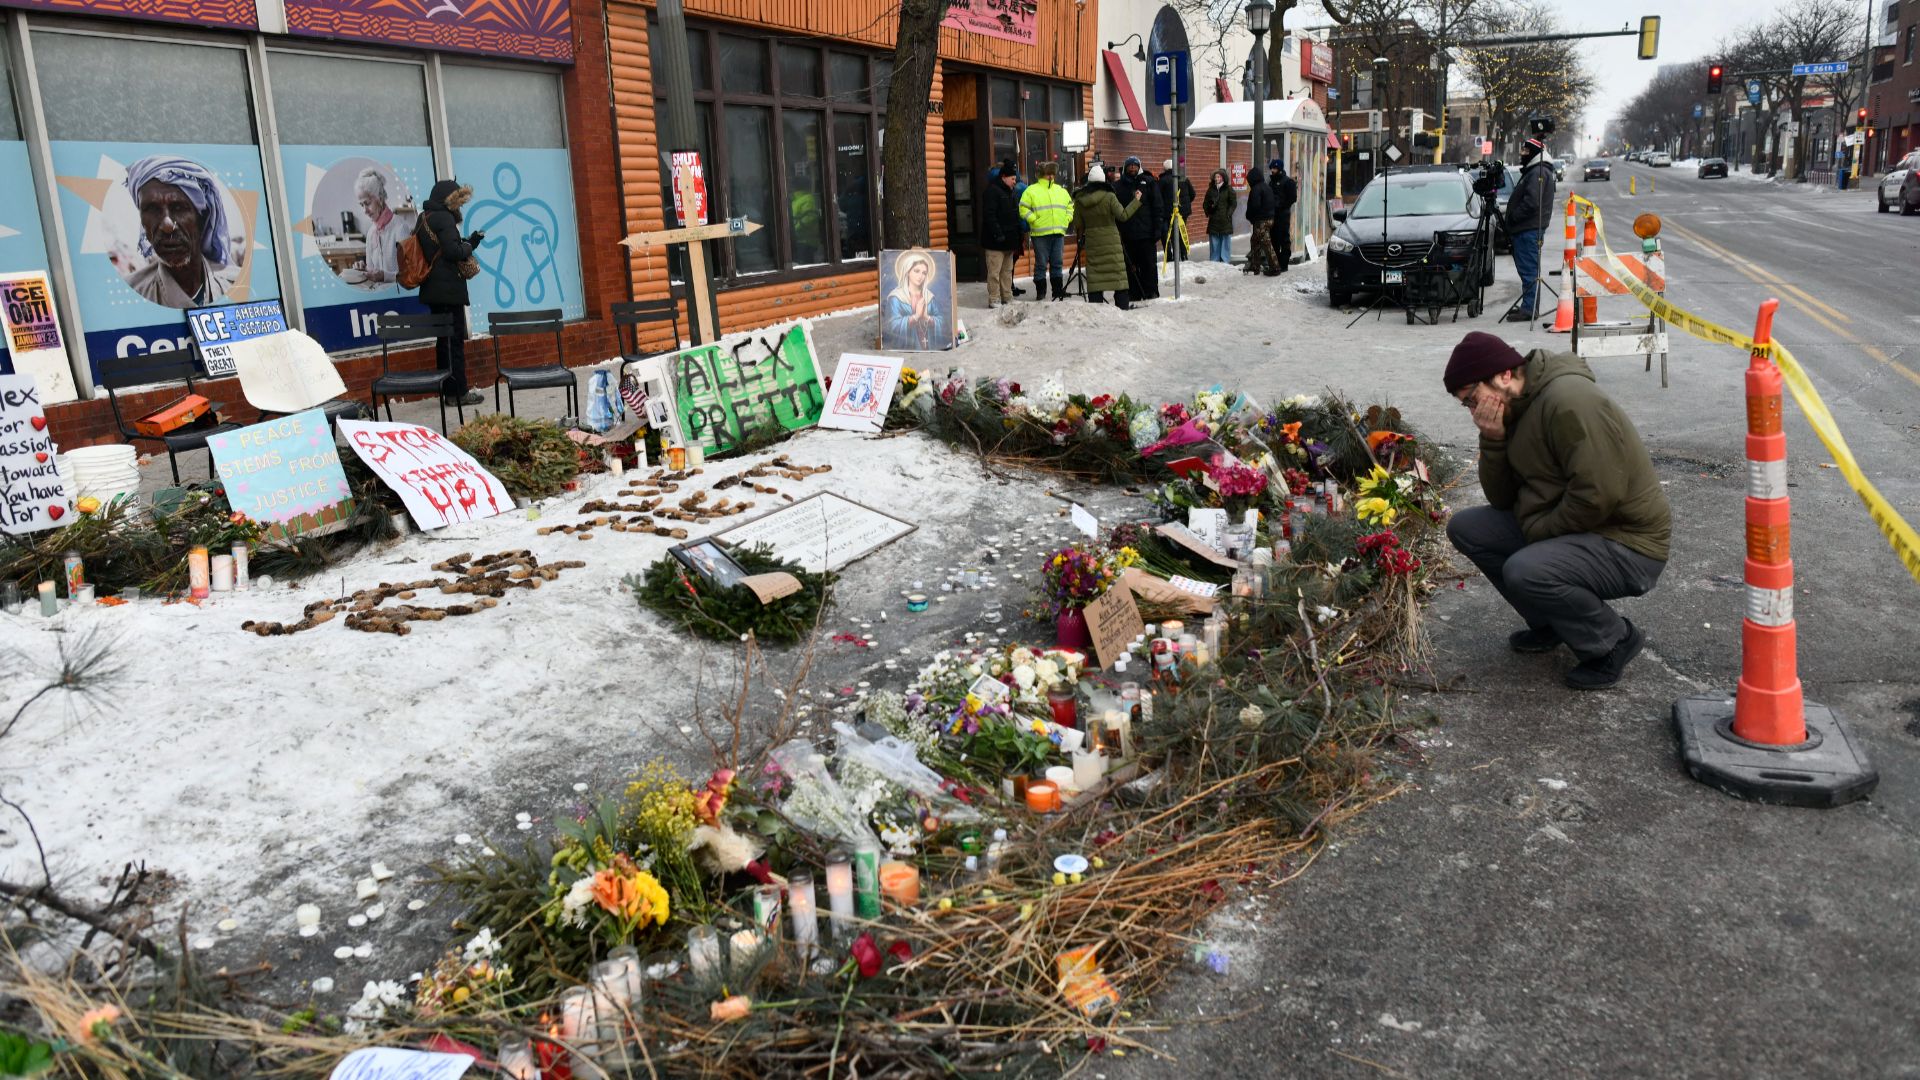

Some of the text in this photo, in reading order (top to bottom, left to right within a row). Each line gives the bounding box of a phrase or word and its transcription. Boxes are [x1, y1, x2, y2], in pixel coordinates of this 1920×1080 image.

[1813, 65, 1834, 73] 26th
[672, 152, 697, 166] SHUT
[4, 286, 46, 303] ICE
[9, 300, 51, 325] OUT!
[234, 303, 281, 322] AMERICAN
[15, 331, 58, 346] JANUARY 23
[190, 311, 231, 342] ICE
[238, 319, 281, 336] GESTAPO
[205, 346, 228, 359] THEY
[683, 332, 795, 397] ALEX
[0, 416, 24, 434] or
[687, 378, 826, 449] PRETTI
[239, 419, 304, 450] PEACE
[353, 427, 449, 467] STOP
[1, 455, 60, 484] toward
[220, 450, 338, 480] STEMS FROM
[0, 481, 65, 506] You have
[252, 478, 330, 513] JUSTICE
[8, 502, 40, 525] For
